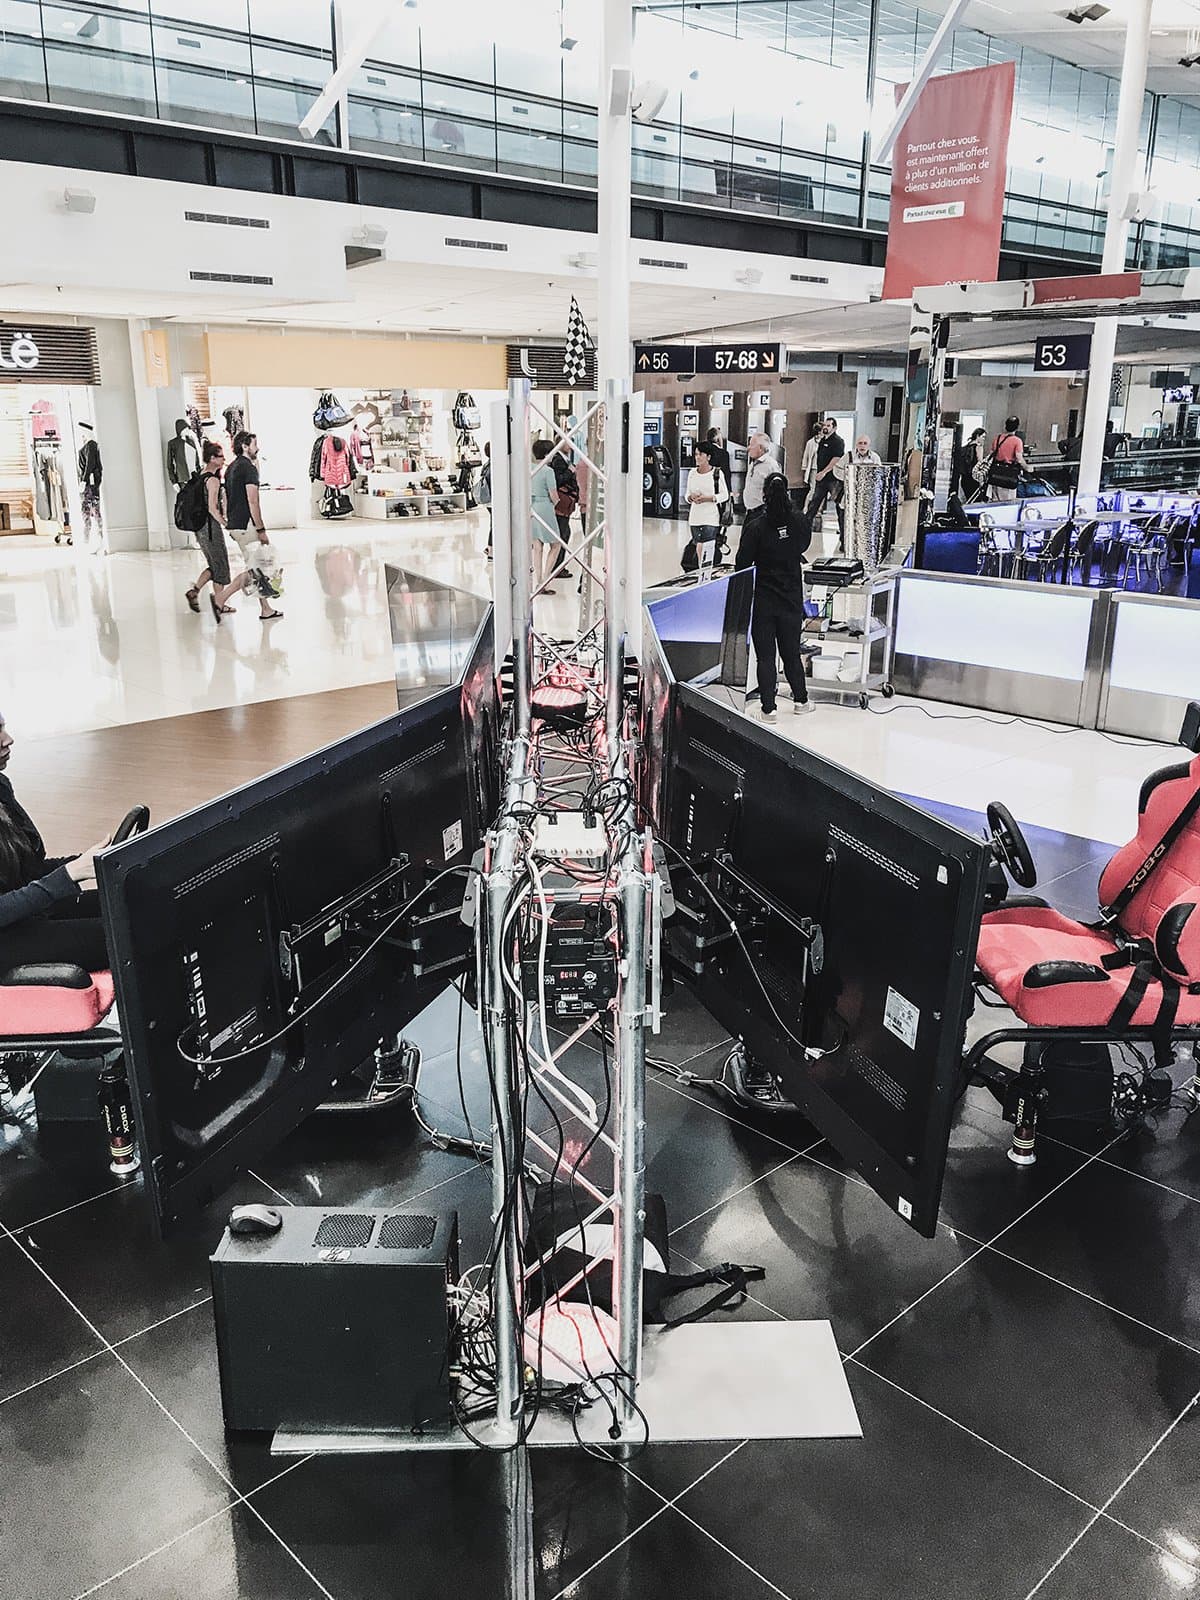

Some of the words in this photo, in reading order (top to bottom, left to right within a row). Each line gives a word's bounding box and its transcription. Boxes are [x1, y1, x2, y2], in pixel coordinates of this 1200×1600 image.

[907, 142, 936, 154] Partout
[937, 138, 956, 149] chez
[906, 158, 918, 167] est
[919, 150, 964, 164] maintenant
[965, 146, 989, 158] offert
[912, 169, 928, 181] plus
[929, 166, 947, 176] d'un
[949, 162, 976, 174] million
[978, 159, 989, 169] de
[904, 183, 929, 193] clients
[930, 174, 982, 190] additionnels.
[652, 352, 669, 370] 56
[715, 350, 758, 370] 57-68
[1040, 344, 1066, 366] 53
